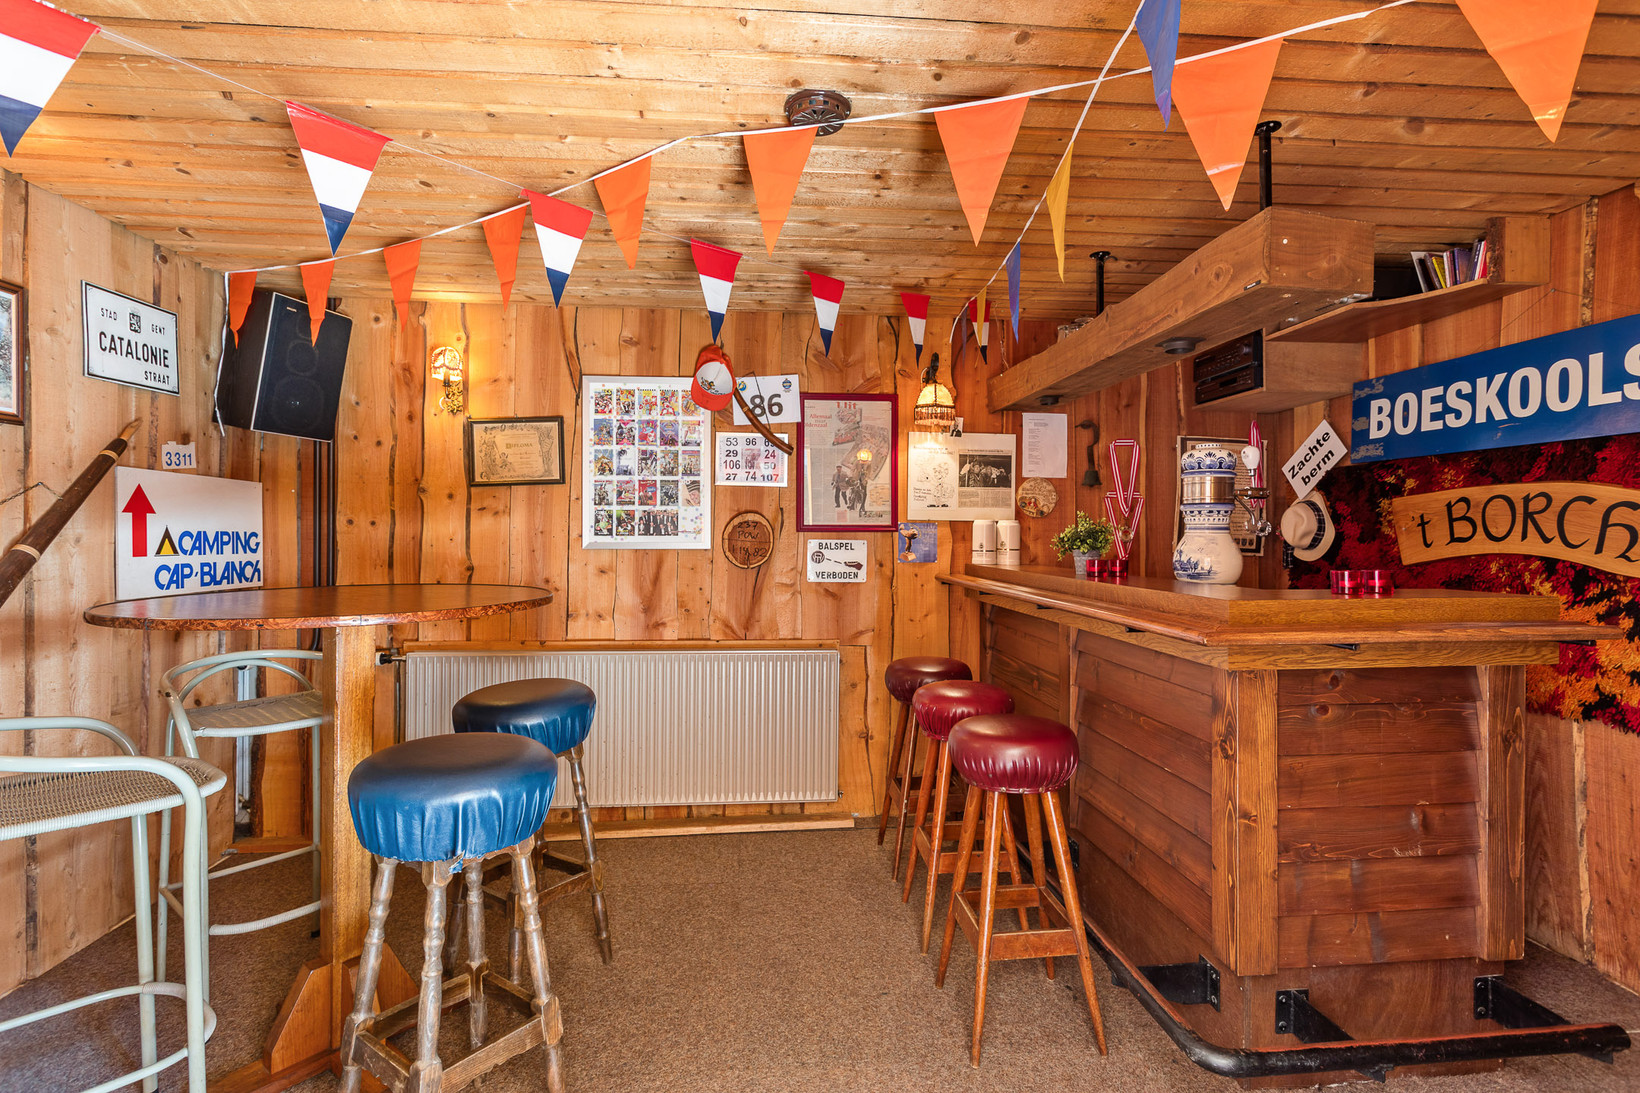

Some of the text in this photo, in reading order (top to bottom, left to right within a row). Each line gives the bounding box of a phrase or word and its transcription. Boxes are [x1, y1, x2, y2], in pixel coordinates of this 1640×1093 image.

[101, 307, 166, 336] STAD GENT
[98, 331, 170, 369] CATALONIE
[144, 370, 170, 386] STRAAT
[749, 393, 784, 418] 86
[725, 437, 739, 447] 53
[745, 437, 757, 446] 96
[165, 451, 192, 467] 3311
[725, 449, 777, 460] 29 24
[1288, 432, 1331, 480] Zachte
[723, 459, 741, 470] 106
[763, 461, 777, 470] 50
[1301, 449, 1335, 486] berm
[725, 471, 779, 482] 27 74 107
[178, 530, 261, 556] CAMPING
[818, 542, 855, 551] BALSPEL
[815, 571, 859, 580] VERBODEN
